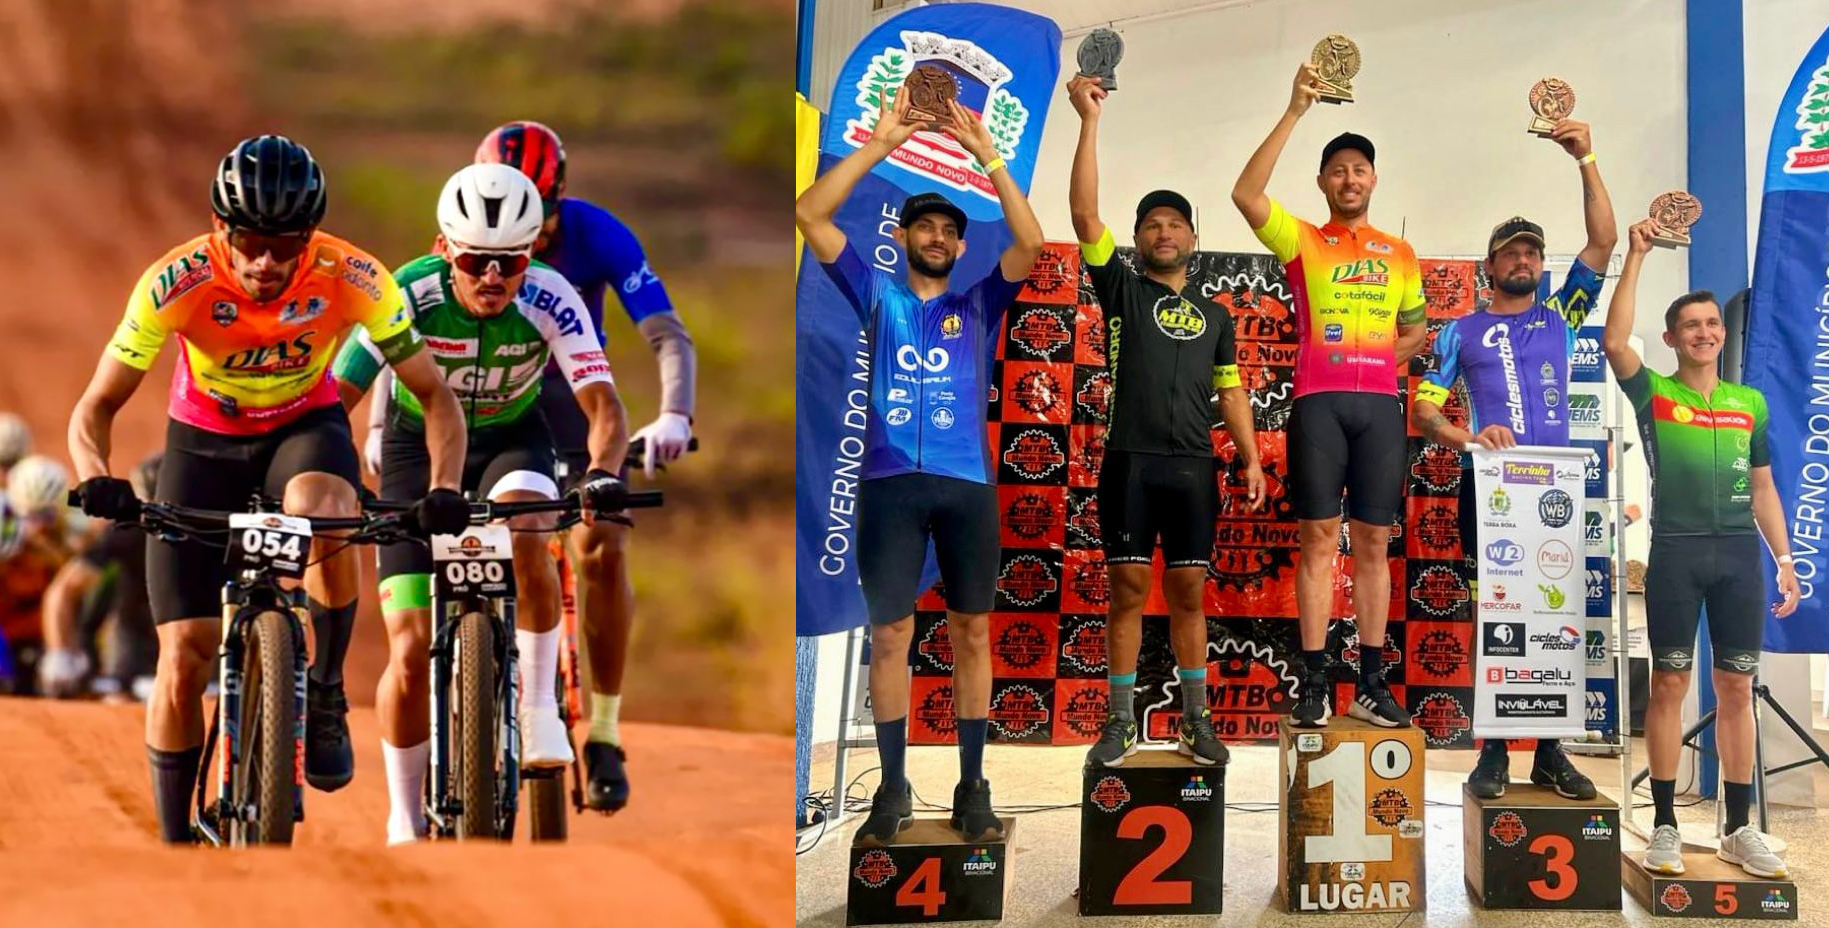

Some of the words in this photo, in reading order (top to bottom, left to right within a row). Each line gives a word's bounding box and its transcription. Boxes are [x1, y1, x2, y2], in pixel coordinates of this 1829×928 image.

[891, 150, 933, 170] MUNDO
[936, 164, 966, 182] NOVO
[346, 256, 377, 278] coife
[1331, 260, 1388, 283] DIAS
[151, 251, 209, 309] DIAS
[1362, 274, 1388, 283] BIKE
[1334, 291, 1386, 303] cotafácil
[533, 287, 583, 336] BLAT
[1158, 309, 1203, 330] MTB
[1234, 315, 1276, 336] TB
[223, 331, 315, 368] DIAS
[1257, 344, 1296, 361] Nov
[1571, 353, 1599, 365] EMS
[1498, 337, 1525, 434] ciclesmotos
[1804, 414, 1829, 454] DO
[1506, 463, 1551, 477] Terrinha
[819, 436, 864, 577] GOVERNO
[844, 389, 869, 430] DO
[1545, 503, 1565, 518] WB
[242, 528, 301, 561] 054
[446, 561, 504, 585] 080
[1487, 567, 1524, 577] Internet
[1481, 602, 1522, 610] MERCOFAR
[1530, 632, 1561, 643] cicles
[1541, 641, 1576, 651] motos
[1505, 667, 1571, 684] bagalu
[1205, 684, 1265, 707] MTB
[1498, 699, 1564, 710] INVIOLÁVEL
[1005, 702, 1030, 710] MTB
[1076, 703, 1102, 711] MTB
[994, 712, 1018, 720] Mundo
[1067, 713, 1091, 721] Mundo
[1167, 716, 1238, 735] Mdo
[1245, 716, 1279, 735] No
[1181, 788, 1212, 797] ITAIPU
[1582, 828, 1612, 836] ITAIPU
[1112, 805, 1192, 906] 2
[963, 862, 996, 871] ITAIPU
[1527, 834, 1578, 901] 3
[895, 857, 946, 916] 4
[1299, 881, 1411, 912] LUGAR
[1714, 883, 1738, 915] 5
[1761, 901, 1789, 909] ITAIPU
